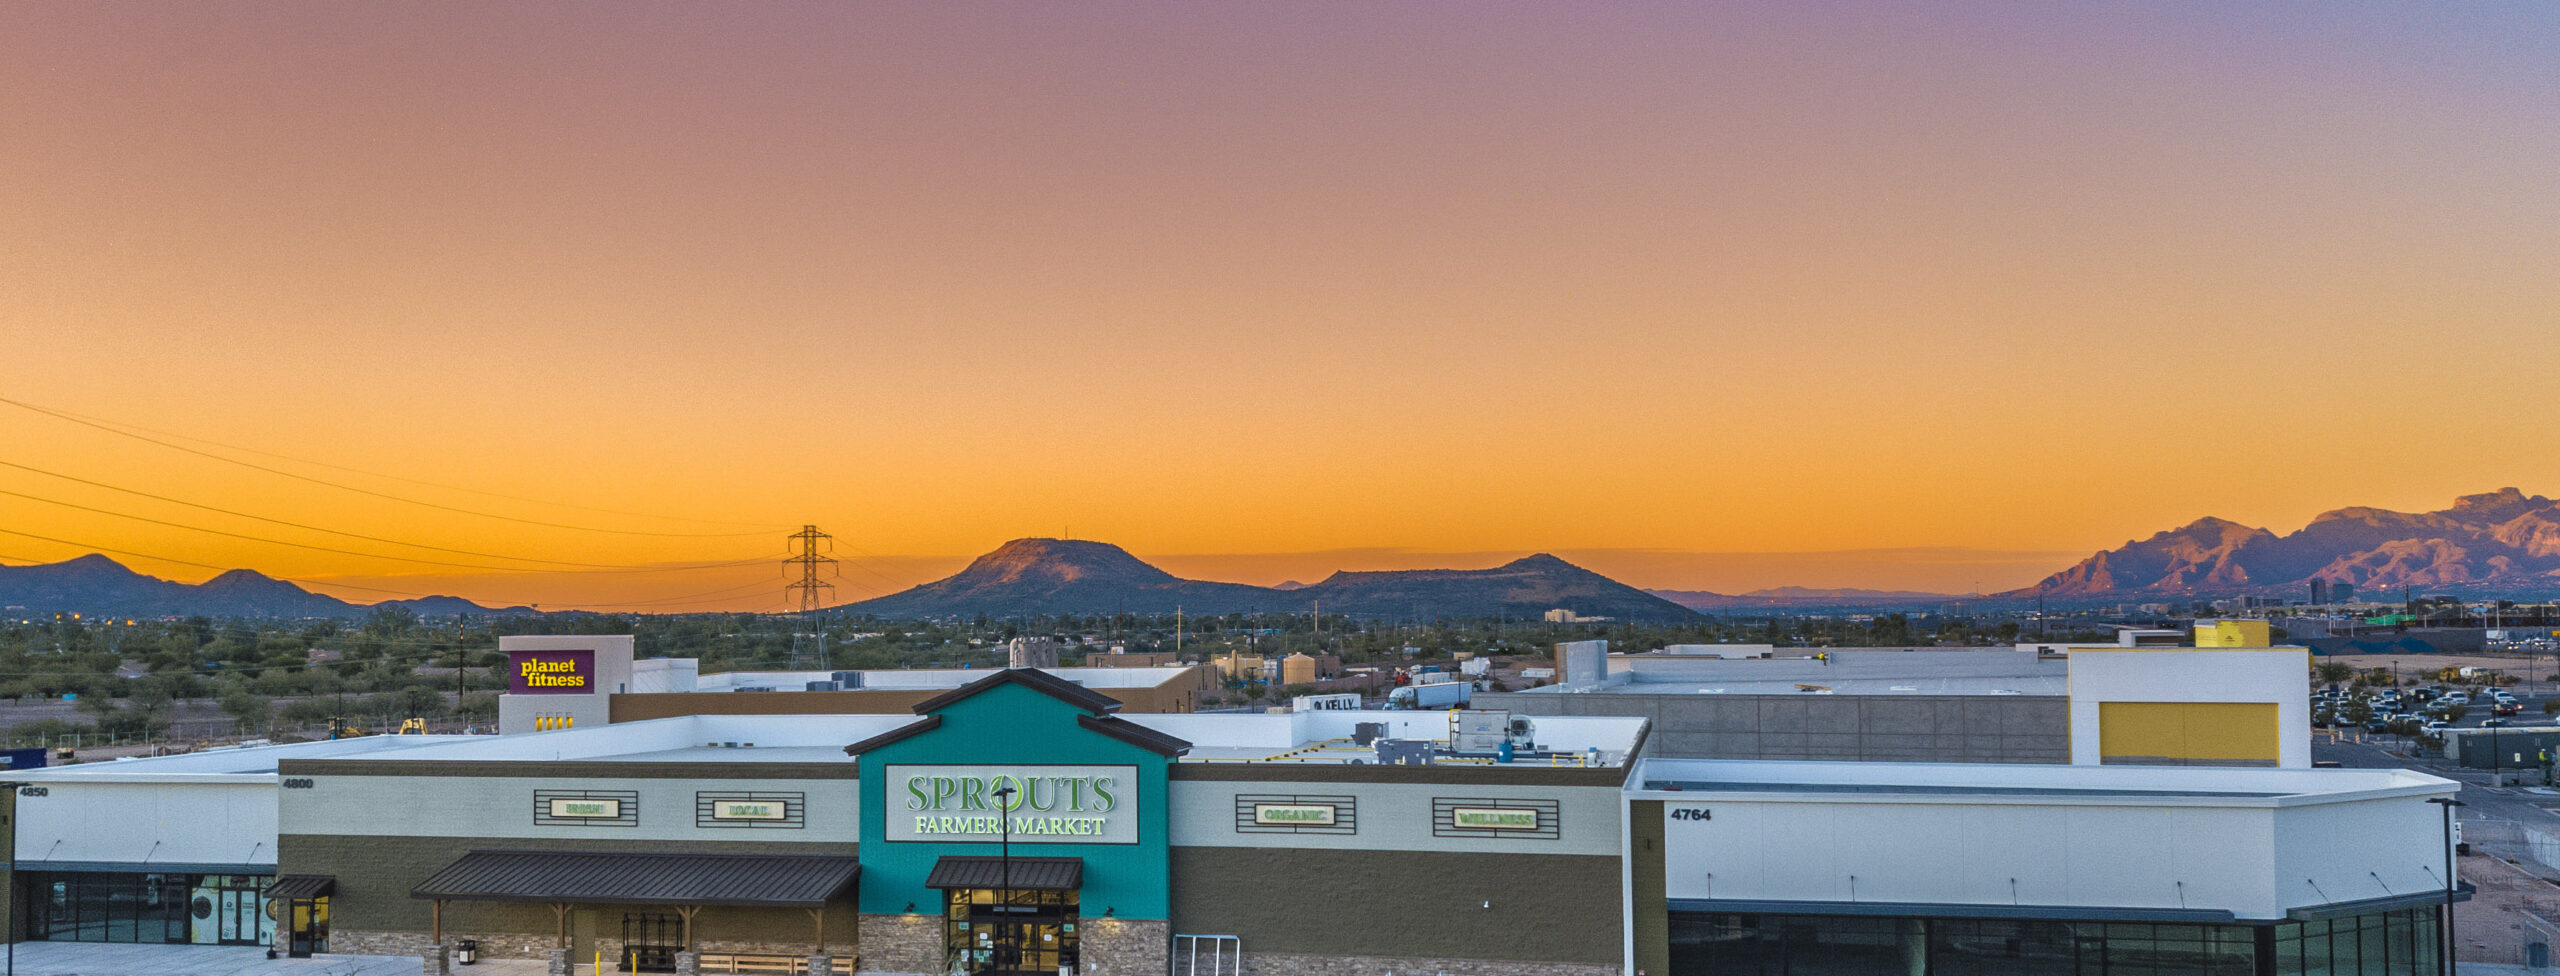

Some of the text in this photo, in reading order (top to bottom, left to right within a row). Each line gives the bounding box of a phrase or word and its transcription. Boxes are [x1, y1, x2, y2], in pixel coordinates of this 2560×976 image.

[521, 658, 575, 676] planet
[527, 672, 585, 686] fitness
[1325, 698, 1354, 710] KELLY
[283, 779, 313, 788] 4800
[20, 786, 48, 797] 4850
[906, 775, 1115, 812] SPROUTS
[729, 805, 771, 816] LOCAL
[1264, 809, 1327, 820] ORGANIC
[1671, 808, 1711, 821] 4764
[1458, 813, 1534, 825] WELLNESS
[915, 816, 1106, 836] FARMERS MARKET
